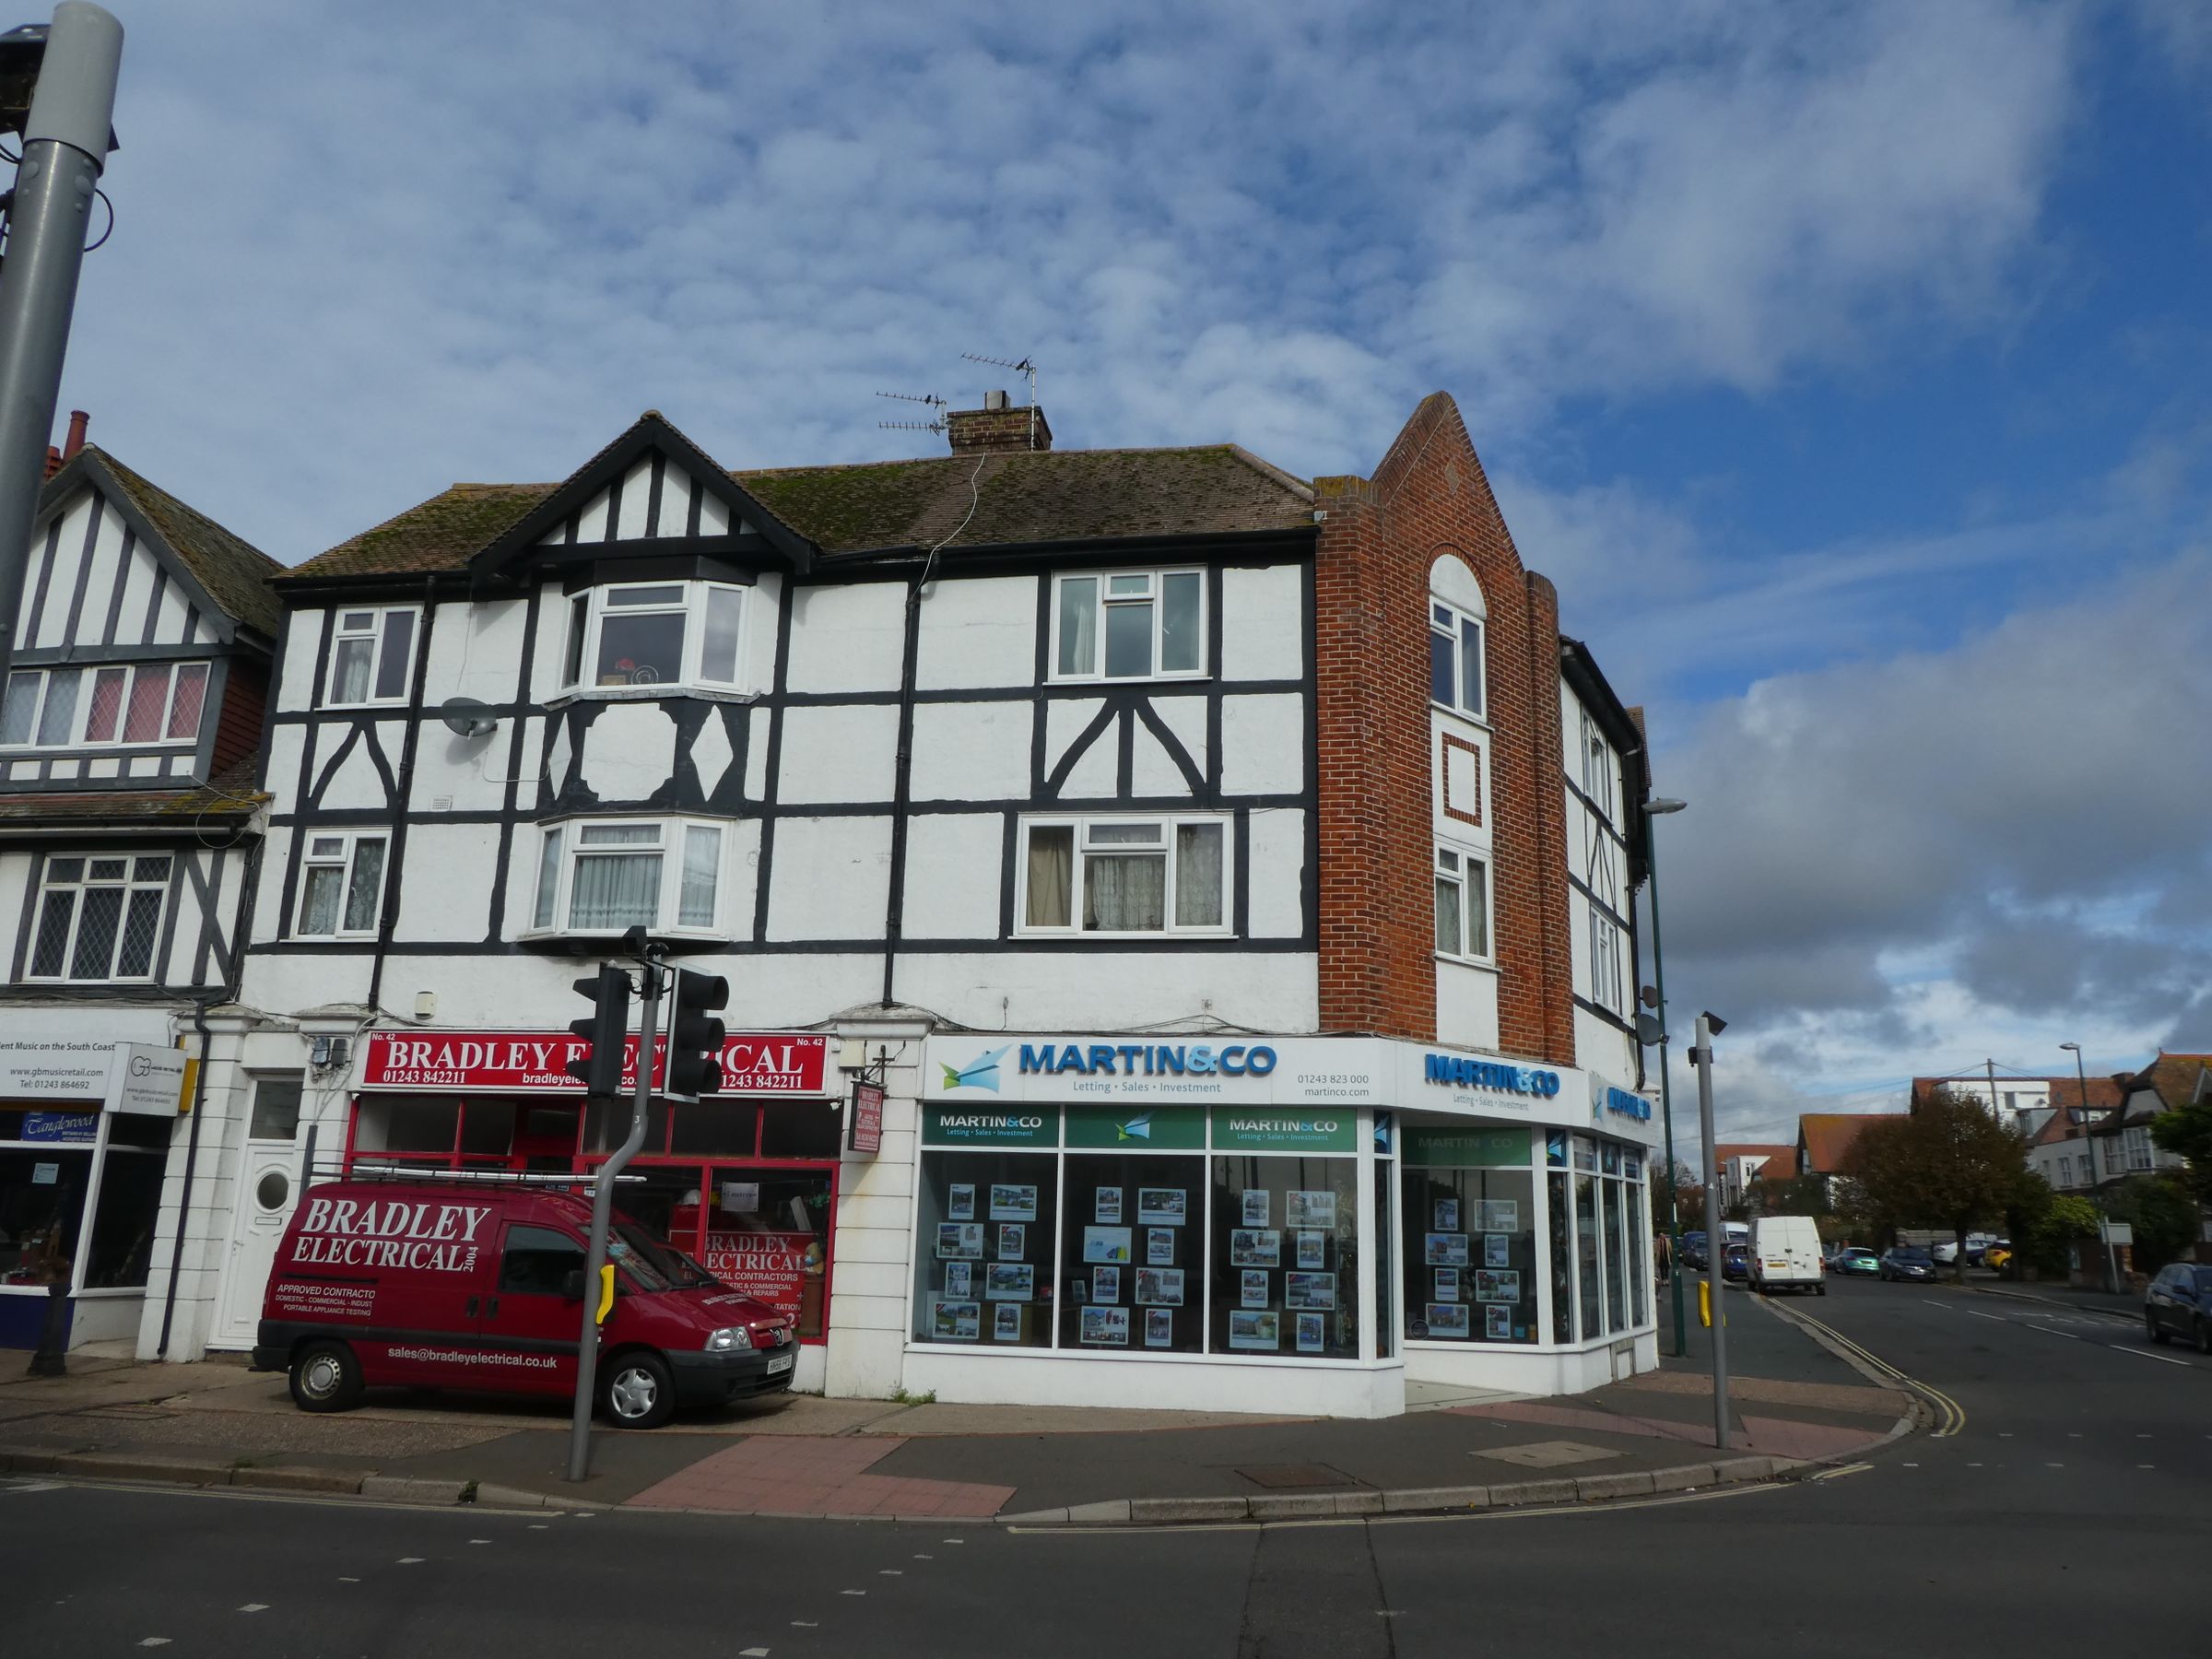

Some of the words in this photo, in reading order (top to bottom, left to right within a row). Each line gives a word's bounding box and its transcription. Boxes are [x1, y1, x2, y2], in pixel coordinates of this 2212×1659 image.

[0, 1042, 13, 1051] ent
[15, 1042, 38, 1051] Music
[52, 1042, 65, 1051] the
[66, 1042, 90, 1051] South
[796, 1038, 811, 1046] No.
[385, 1041, 557, 1071] BRADLEY
[1019, 1044, 1277, 1075] MARTIN&CO
[10, 1067, 103, 1077] www.gbmusicretail.com
[382, 1070, 419, 1083] 01243
[423, 1071, 465, 1084] 842211
[1425, 1053, 1559, 1096] MARTIN&CO
[34, 1080, 58, 1088] 01243
[60, 1081, 89, 1089] 864692
[722, 1075, 752, 1088] 1243
[756, 1076, 803, 1088] 842211
[1298, 1075, 1327, 1084] 01243
[1330, 1075, 1347, 1084] 823
[1350, 1075, 1369, 1084] 000
[1073, 1081, 1111, 1094] Letting
[1122, 1082, 1149, 1092] Sales
[1159, 1082, 1221, 1093] Investment
[1304, 1088, 1369, 1097] martinco.com
[1453, 1093, 1474, 1108] Letting
[1478, 1096, 1494, 1107] Sales
[1498, 1099, 1529, 1111] Investment
[25, 1115, 94, 1137] Tanglewood
[634, 1115, 641, 1124] 3
[939, 1115, 1042, 1128] MARTIN&CO
[1230, 1119, 1337, 1132] MARTIN&CO
[947, 1128, 970, 1136] Letting
[1237, 1133, 1262, 1141] Letting
[300, 1198, 492, 1241] BRADLEY
[291, 1236, 465, 1272] ELECTRICAL
[463, 1246, 479, 1273] 2004
[735, 1272, 798, 1281] CONTRACTORS
[277, 1284, 322, 1295] APPROVED
[323, 1287, 376, 1299] CONTRACTO
[276, 1295, 304, 1303] DOMESTIC
[309, 1297, 346, 1306] COMMERCIAL
[284, 1304, 312, 1312] PORTABLE
[313, 1306, 346, 1314] APPLIANCE
[346, 1308, 371, 1316] TESTING
[388, 1347, 558, 1369] sales@bradleyelectrical.co.uk
